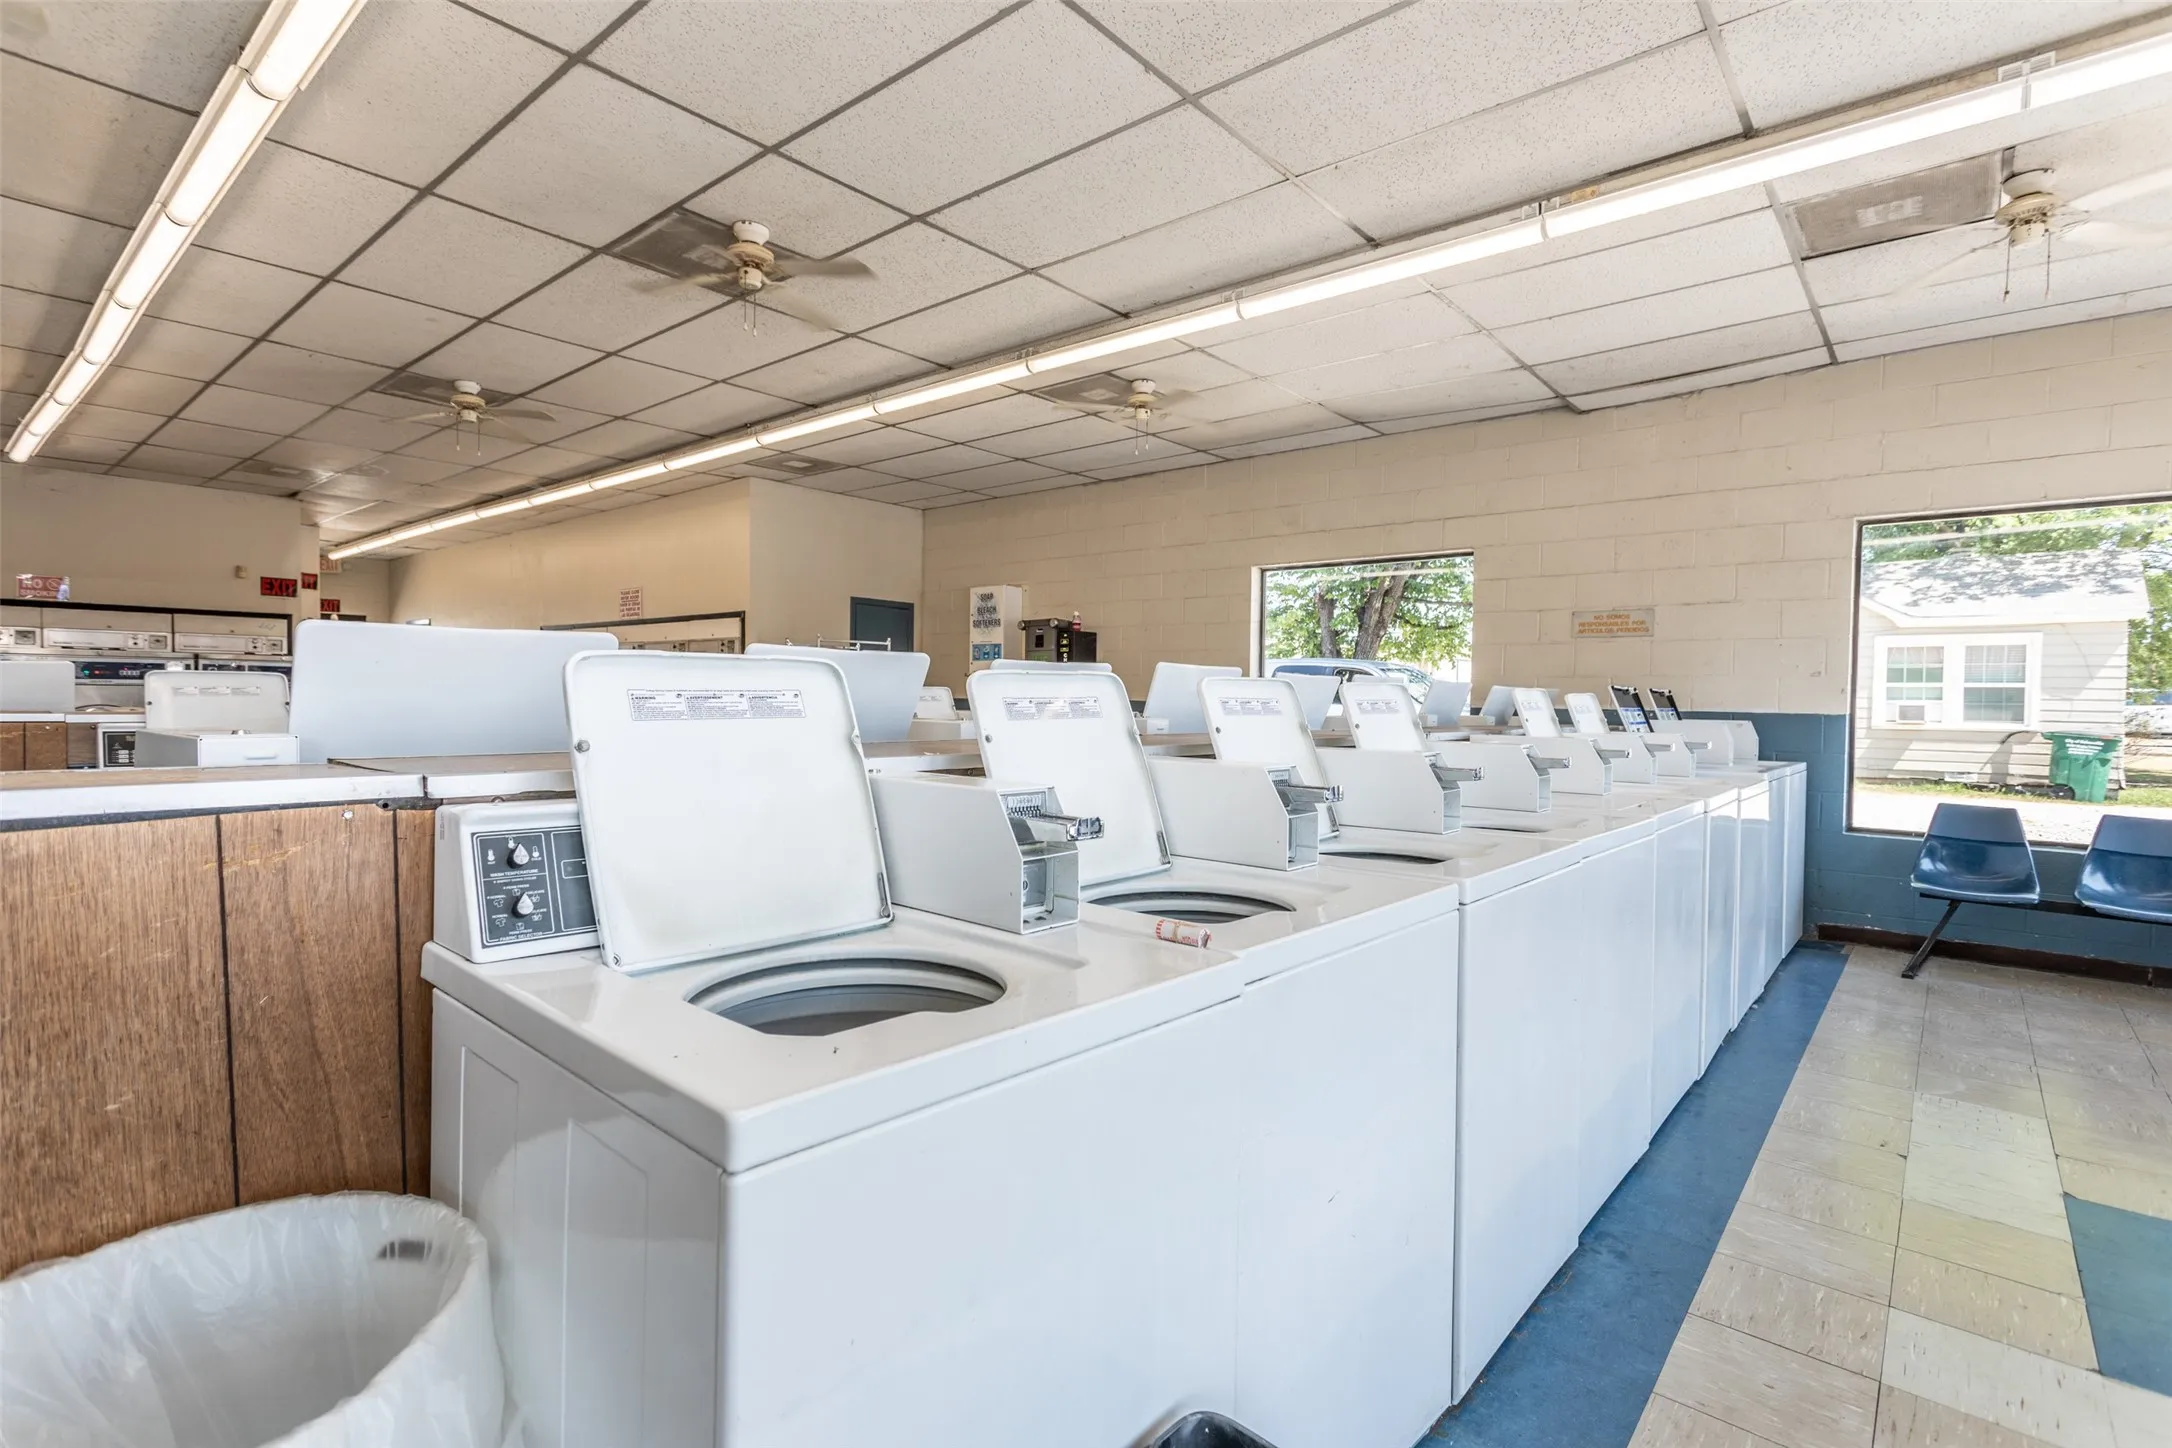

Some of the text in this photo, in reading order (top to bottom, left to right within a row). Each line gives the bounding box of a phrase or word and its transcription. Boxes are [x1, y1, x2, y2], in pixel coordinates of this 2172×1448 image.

[263, 578, 296, 595] EXIT
[20, 589, 57, 597] SMOKI
[980, 592, 994, 602] SOAP
[320, 600, 339, 612] XIT
[977, 606, 997, 615] BLEACH
[972, 618, 1001, 629] SOFTENERS
[1577, 627, 1615, 635] ARTICULOS
